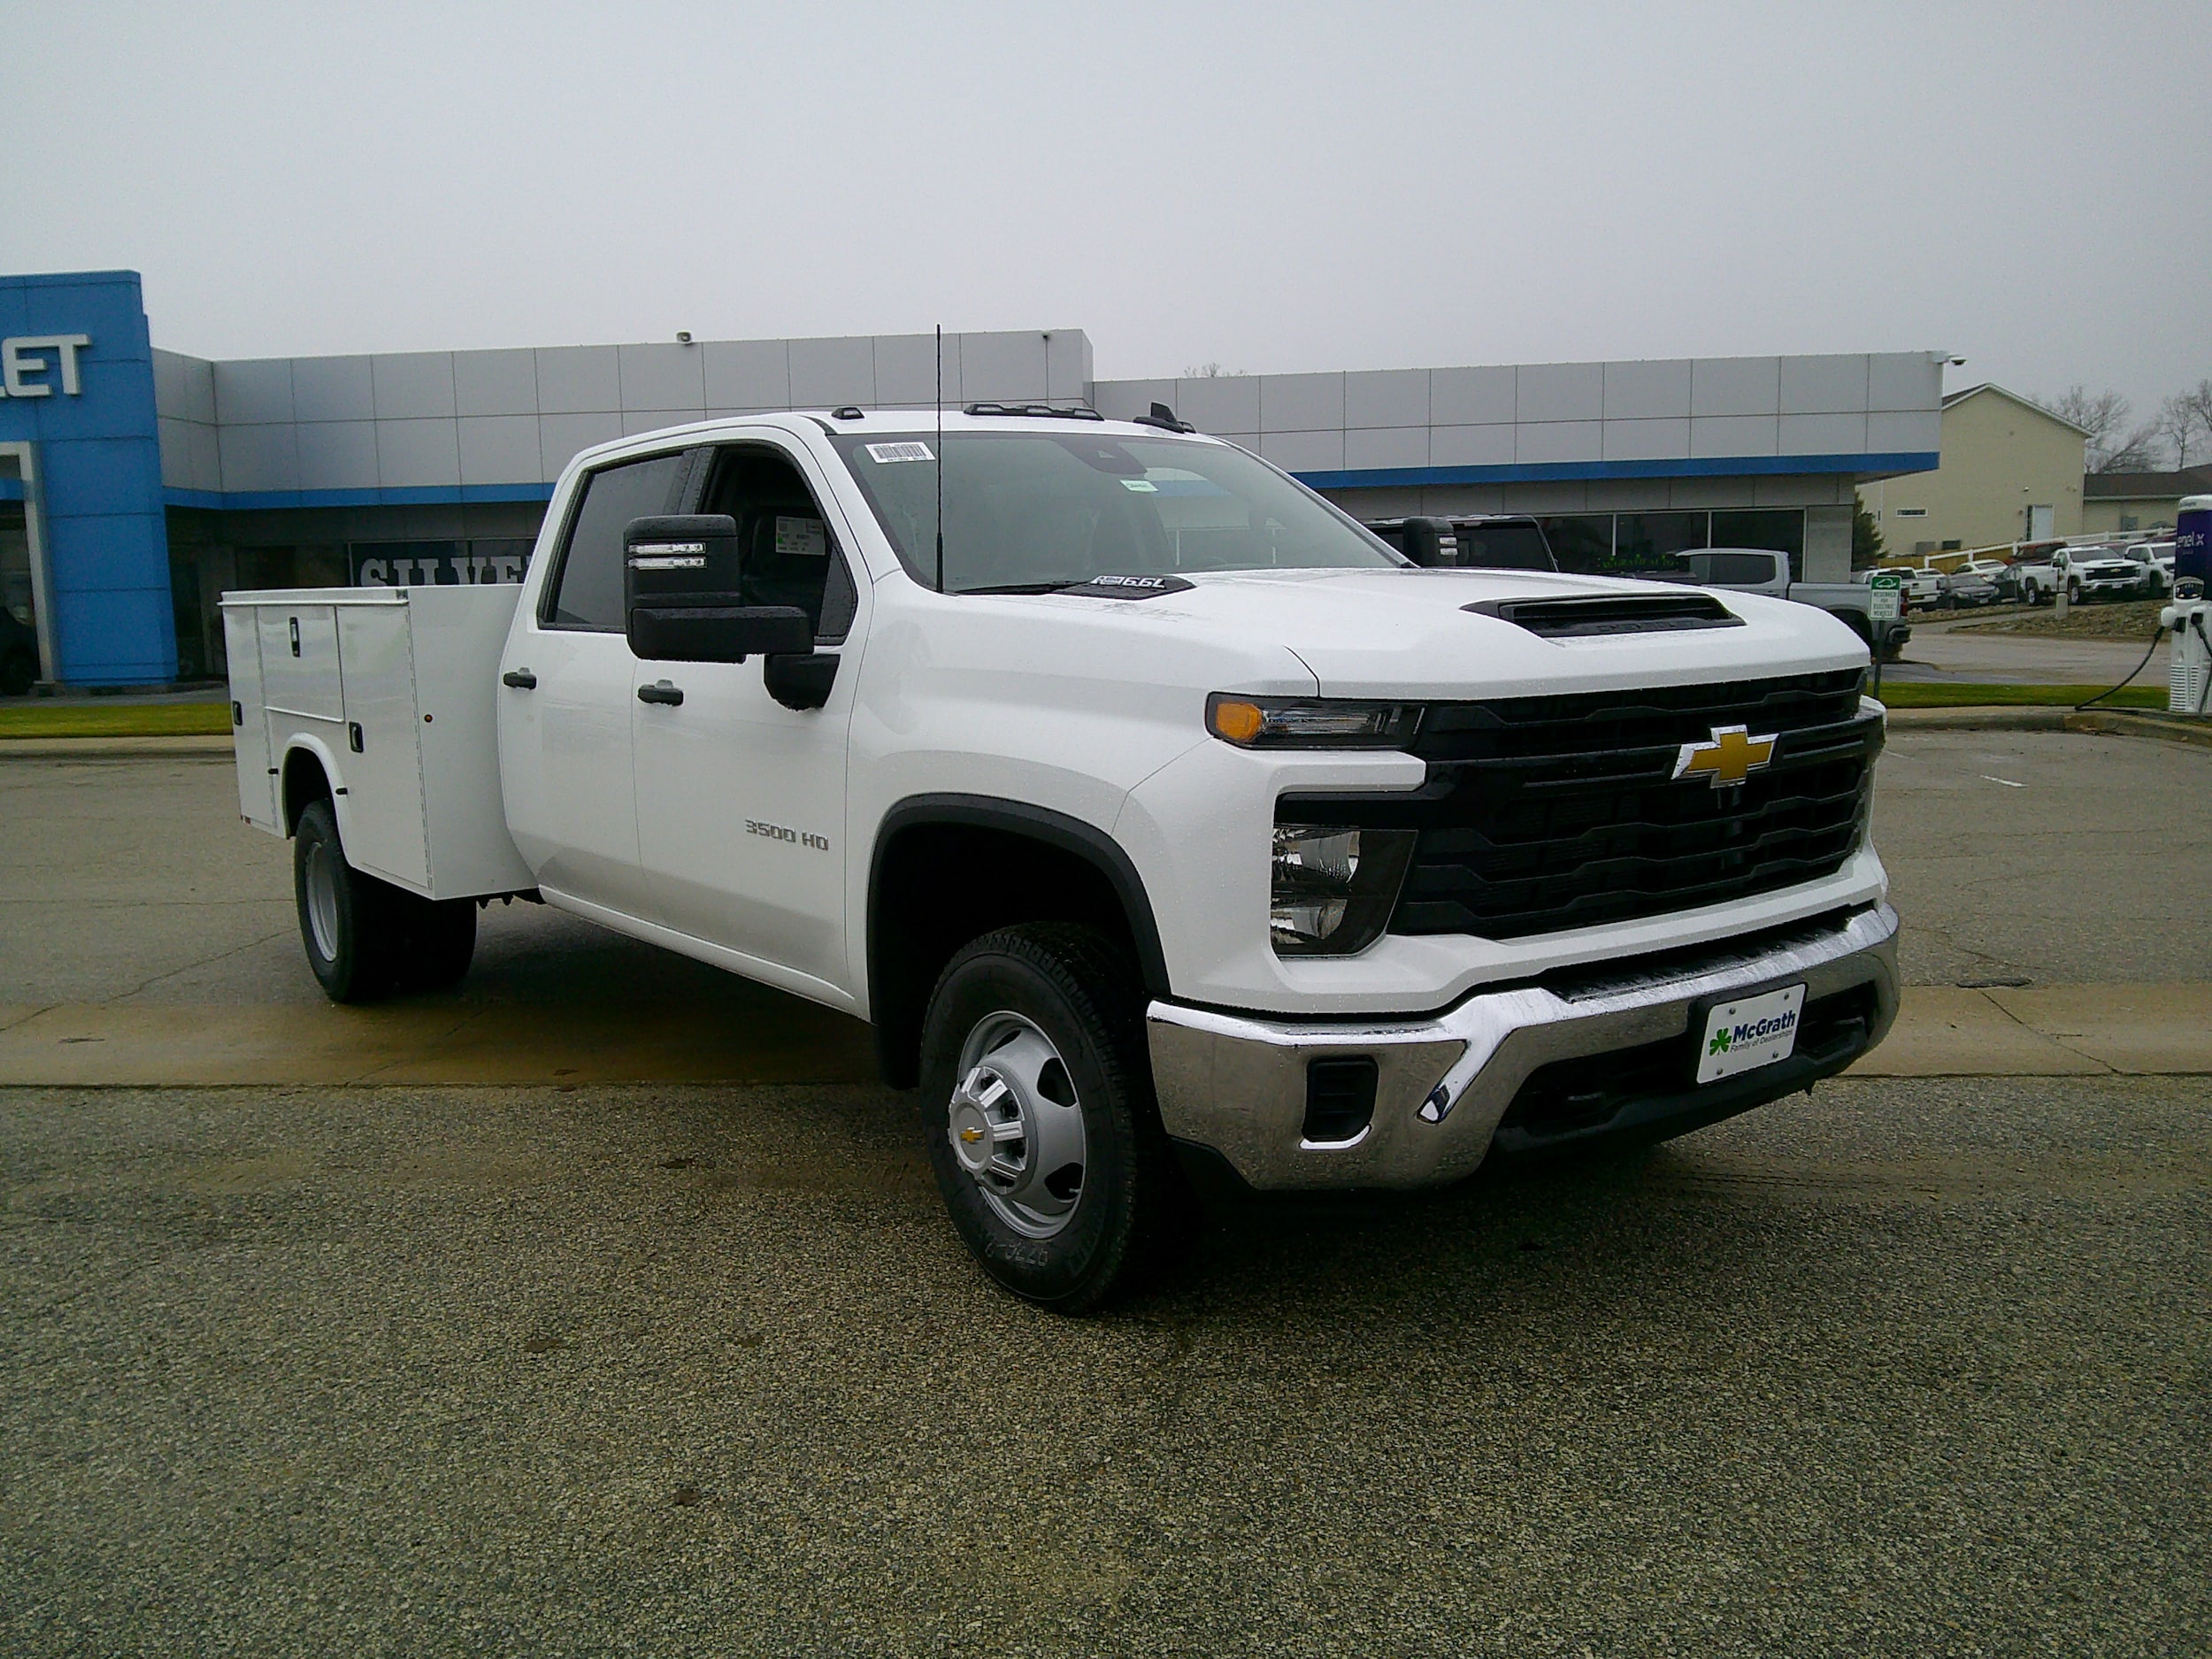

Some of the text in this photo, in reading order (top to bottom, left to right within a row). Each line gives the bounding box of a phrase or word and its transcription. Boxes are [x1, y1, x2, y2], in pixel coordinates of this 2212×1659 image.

[0, 334, 91, 397] ET
[744, 818, 829, 851] 3500 HD
[1732, 1010, 1796, 1043] McGrath
